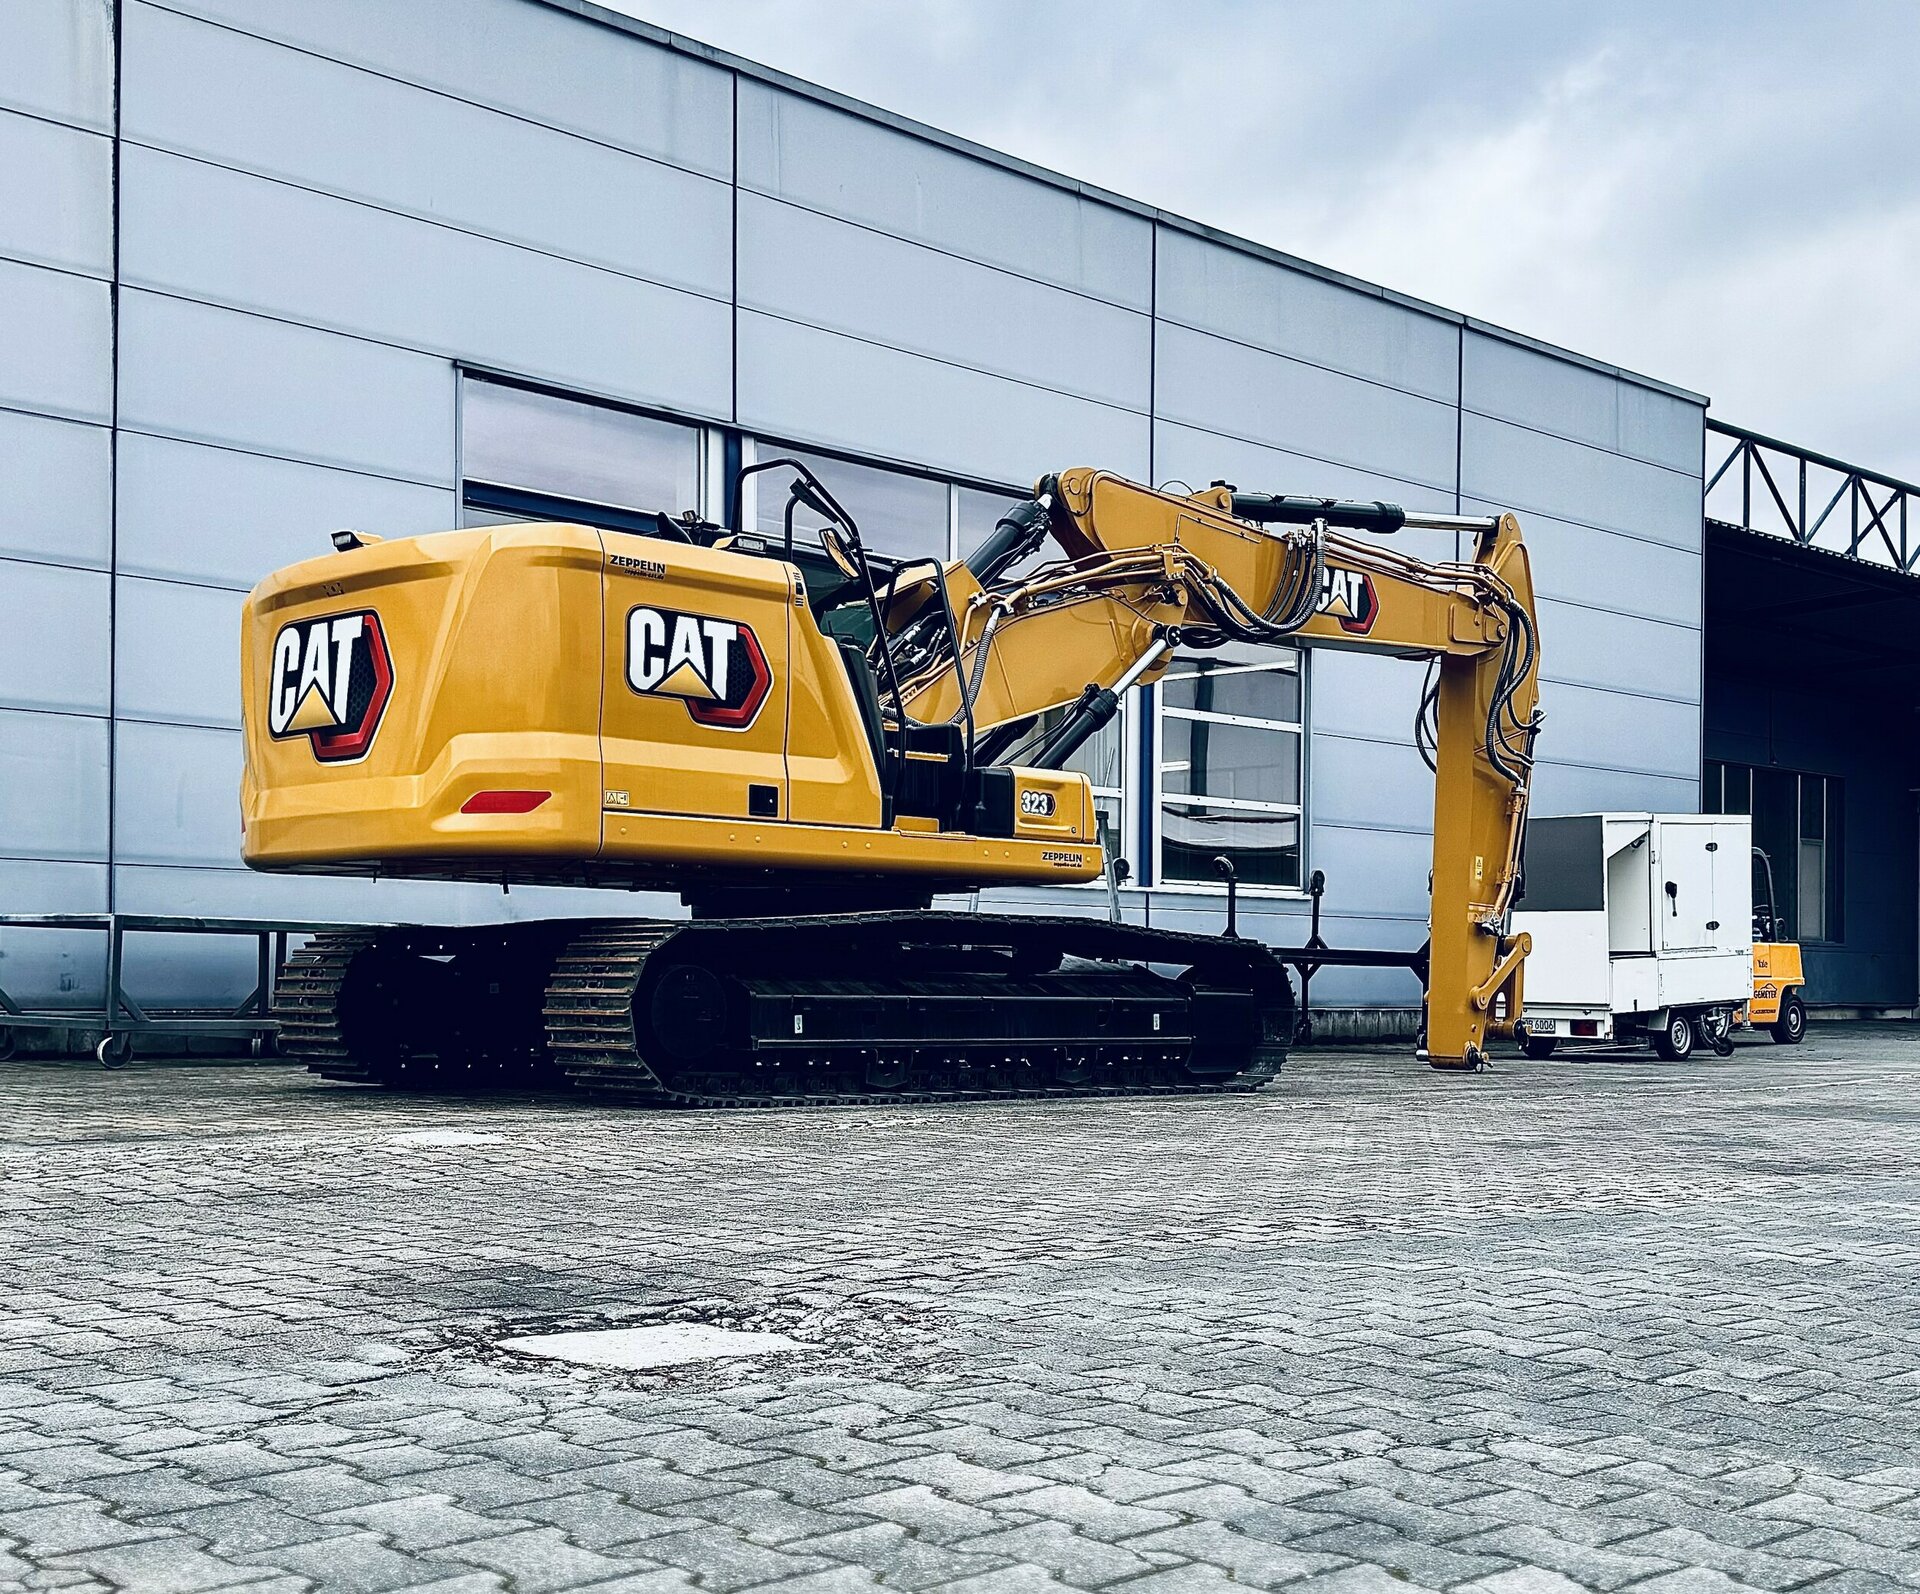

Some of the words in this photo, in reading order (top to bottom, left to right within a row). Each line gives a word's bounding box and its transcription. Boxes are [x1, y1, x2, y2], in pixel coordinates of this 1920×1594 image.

[609, 554, 666, 574] ZEPPELIN
[630, 607, 738, 701] CAT
[270, 615, 364, 734] CAT
[1021, 790, 1048, 815] 323
[1042, 851, 1082, 863] ZEPPELIN
[1535, 1019, 1553, 1030] 6006
